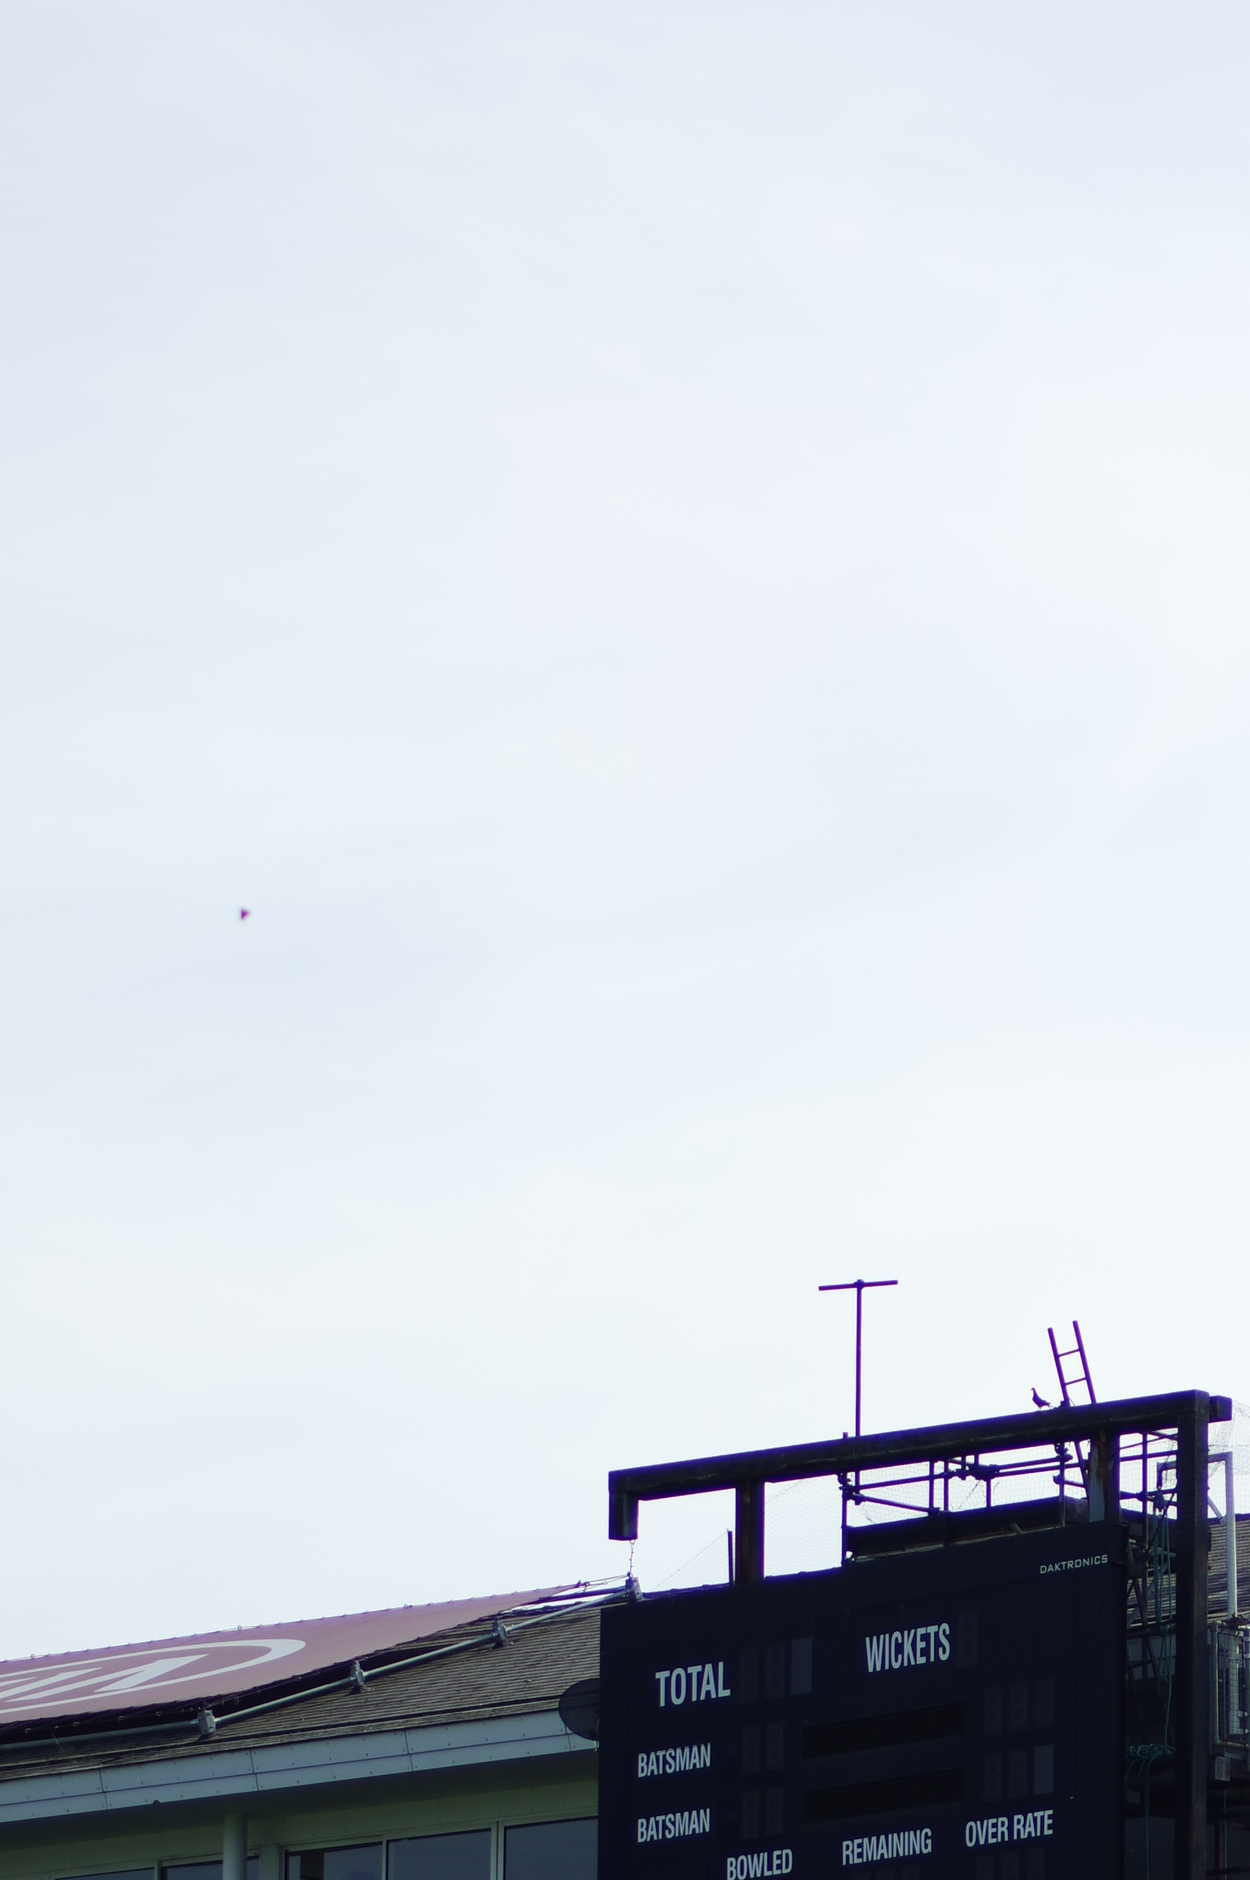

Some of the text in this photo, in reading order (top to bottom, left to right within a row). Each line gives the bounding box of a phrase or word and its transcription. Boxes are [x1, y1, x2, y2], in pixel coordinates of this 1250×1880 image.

[1040, 1555, 1107, 1574] DAKTRONICS
[866, 1623, 950, 1672] WICKETS
[656, 1662, 730, 1706] TOTAL
[638, 1743, 710, 1777] BATSMAN
[638, 1808, 709, 1842] BATSMAN
[966, 1810, 1053, 1847] OVER RATE
[843, 1828, 931, 1865] REMAINING
[727, 1849, 792, 1880] BOWLED
